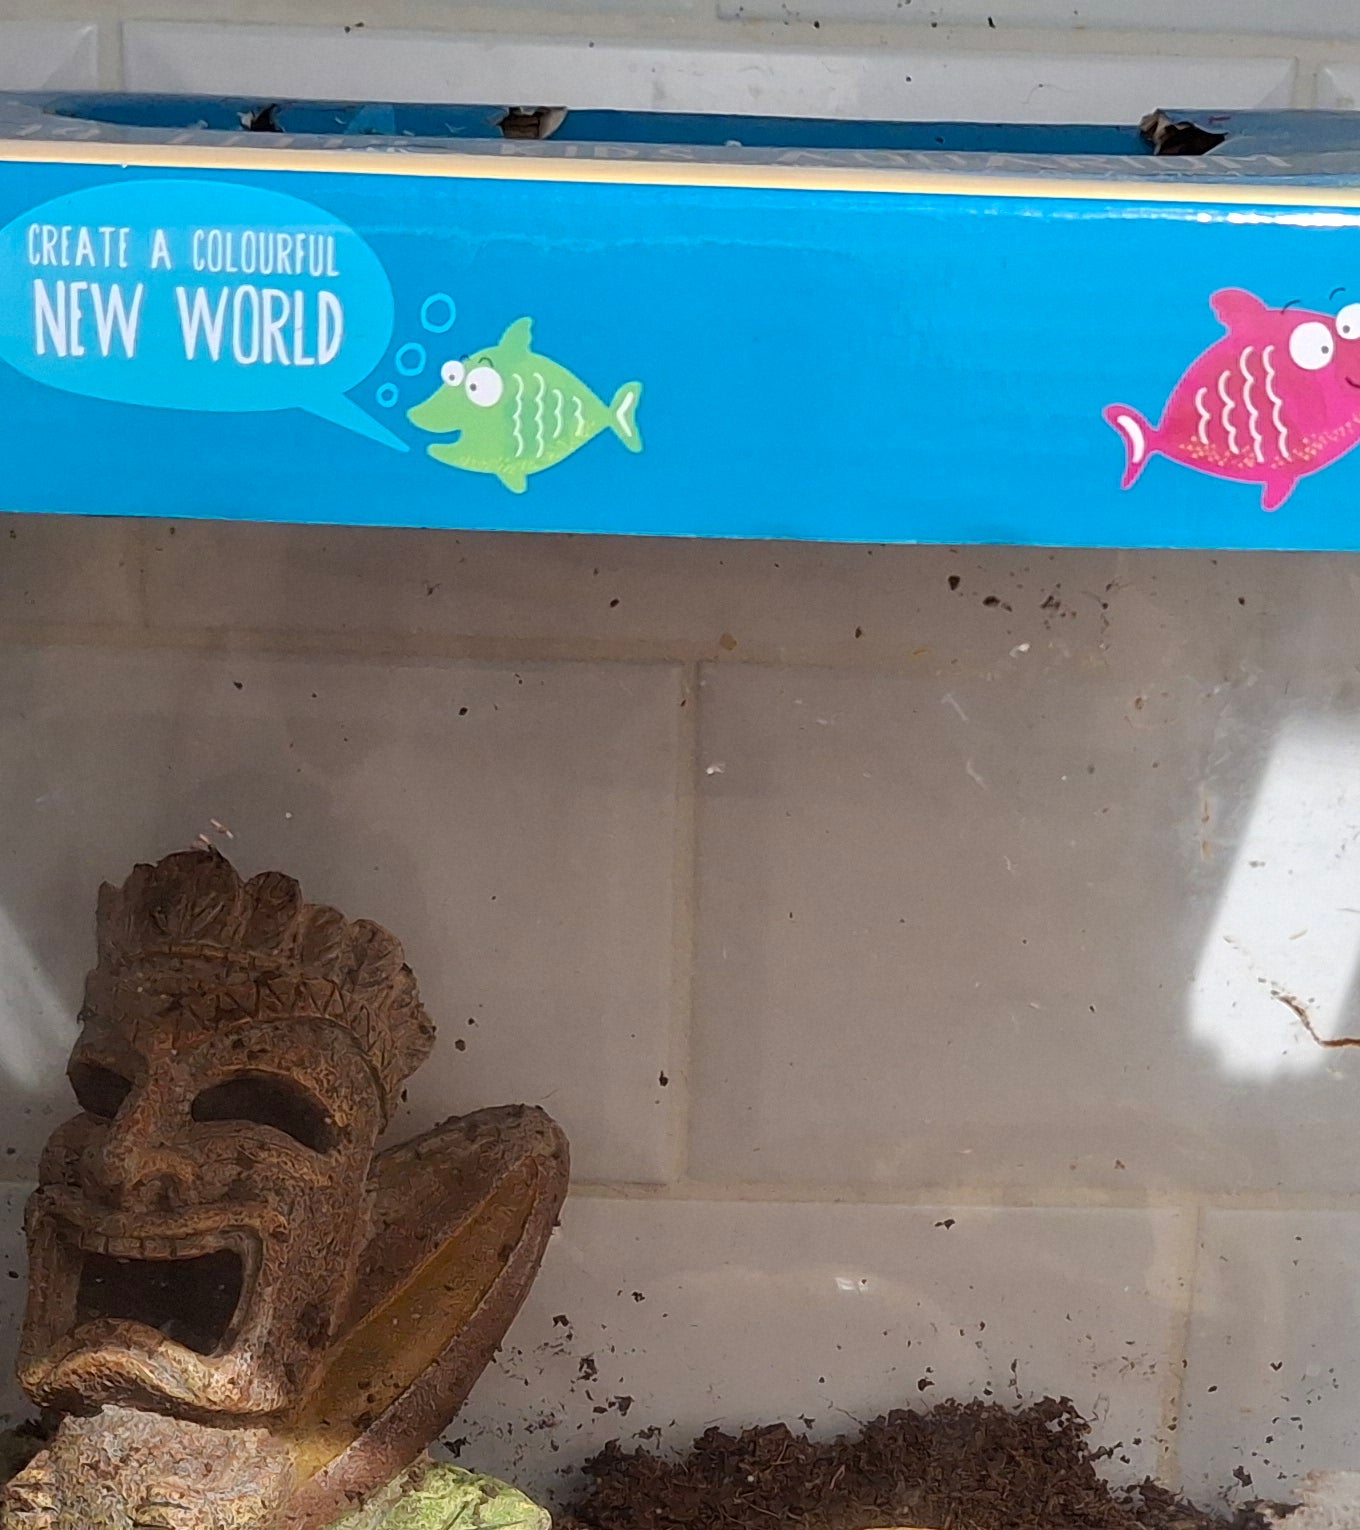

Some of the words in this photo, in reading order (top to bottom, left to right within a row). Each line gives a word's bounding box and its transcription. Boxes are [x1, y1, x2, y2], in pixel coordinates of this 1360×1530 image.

[27, 222, 129, 269] CREATE
[150, 227, 172, 270] A
[192, 229, 340, 278] COLOURFUL
[32, 278, 145, 359] NEW
[176, 285, 343, 367] WORLD
